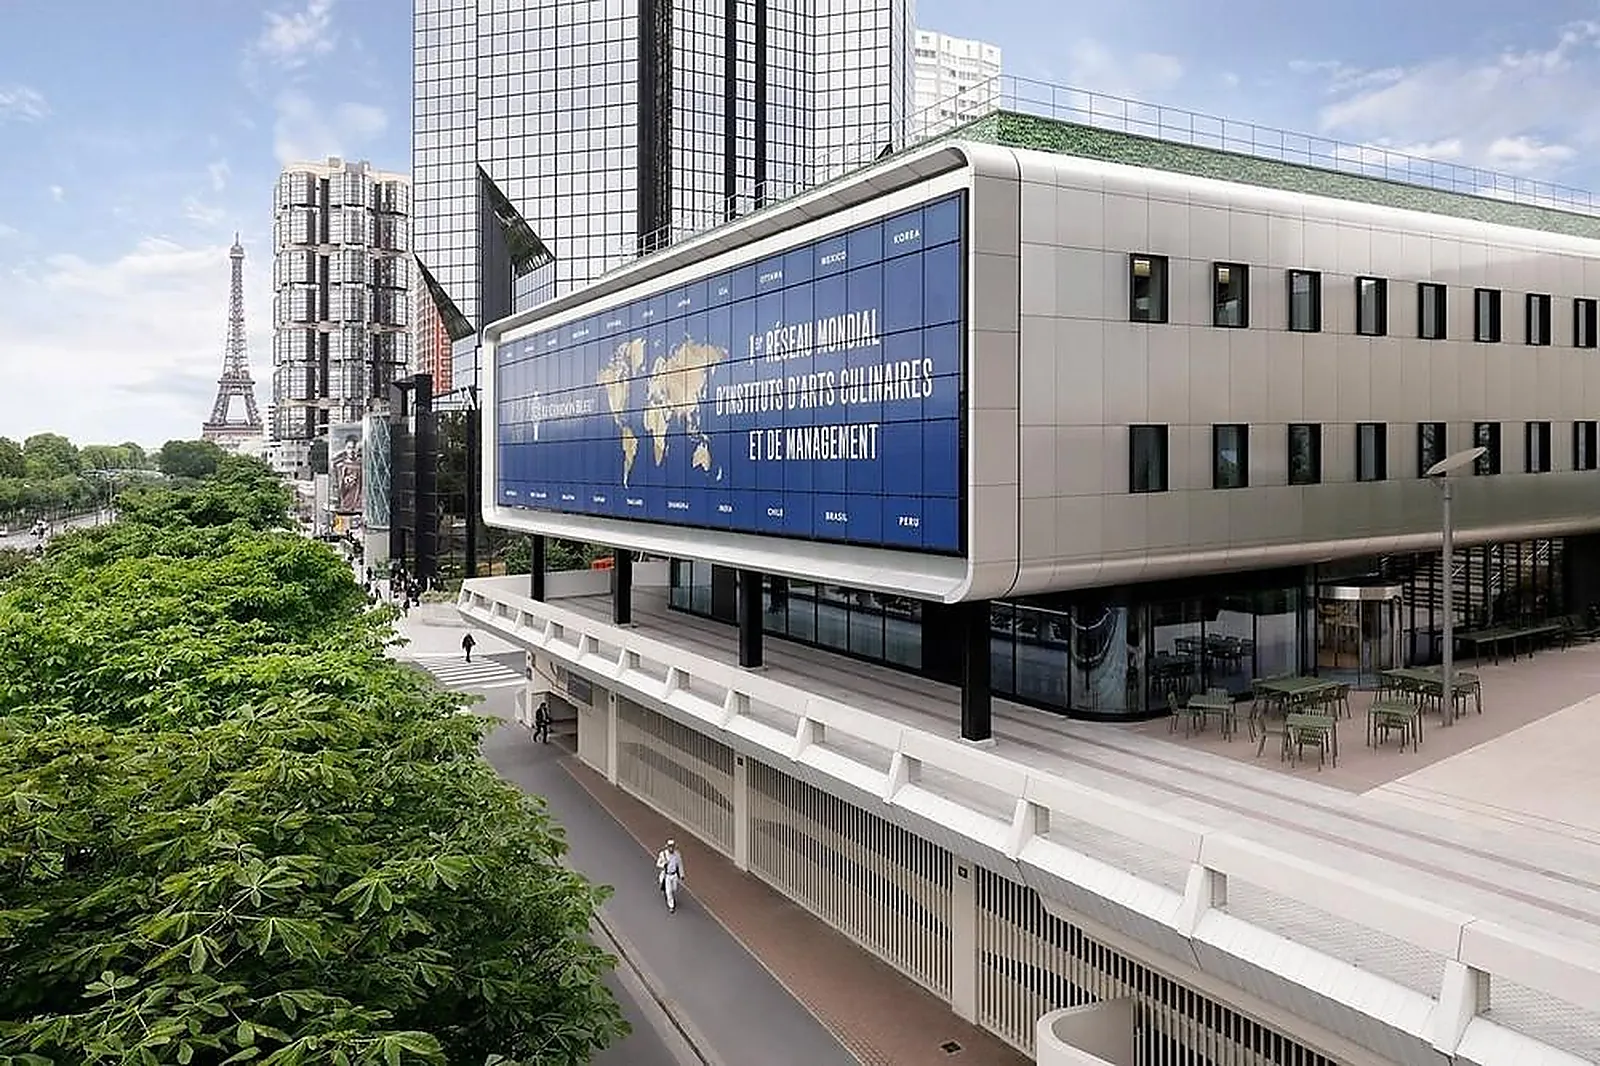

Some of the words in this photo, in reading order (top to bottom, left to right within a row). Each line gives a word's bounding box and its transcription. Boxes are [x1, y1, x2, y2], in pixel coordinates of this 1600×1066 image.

[892, 229, 920, 244] KOREA
[821, 251, 847, 265] MEXICO
[759, 271, 783, 284] OTTAWA
[765, 320, 813, 364] RÉSEAU
[816, 308, 880, 353] MONDIAL
[715, 378, 783, 416] D'INSTITUTS
[788, 371, 835, 410] D'ARTS
[840, 357, 934, 405] CULINAIRES
[749, 430, 763, 461] ET
[767, 428, 782, 460] DE
[786, 423, 879, 460] MANAGEMENT
[825, 511, 848, 522] BRASIL
[899, 516, 920, 527] PERU
